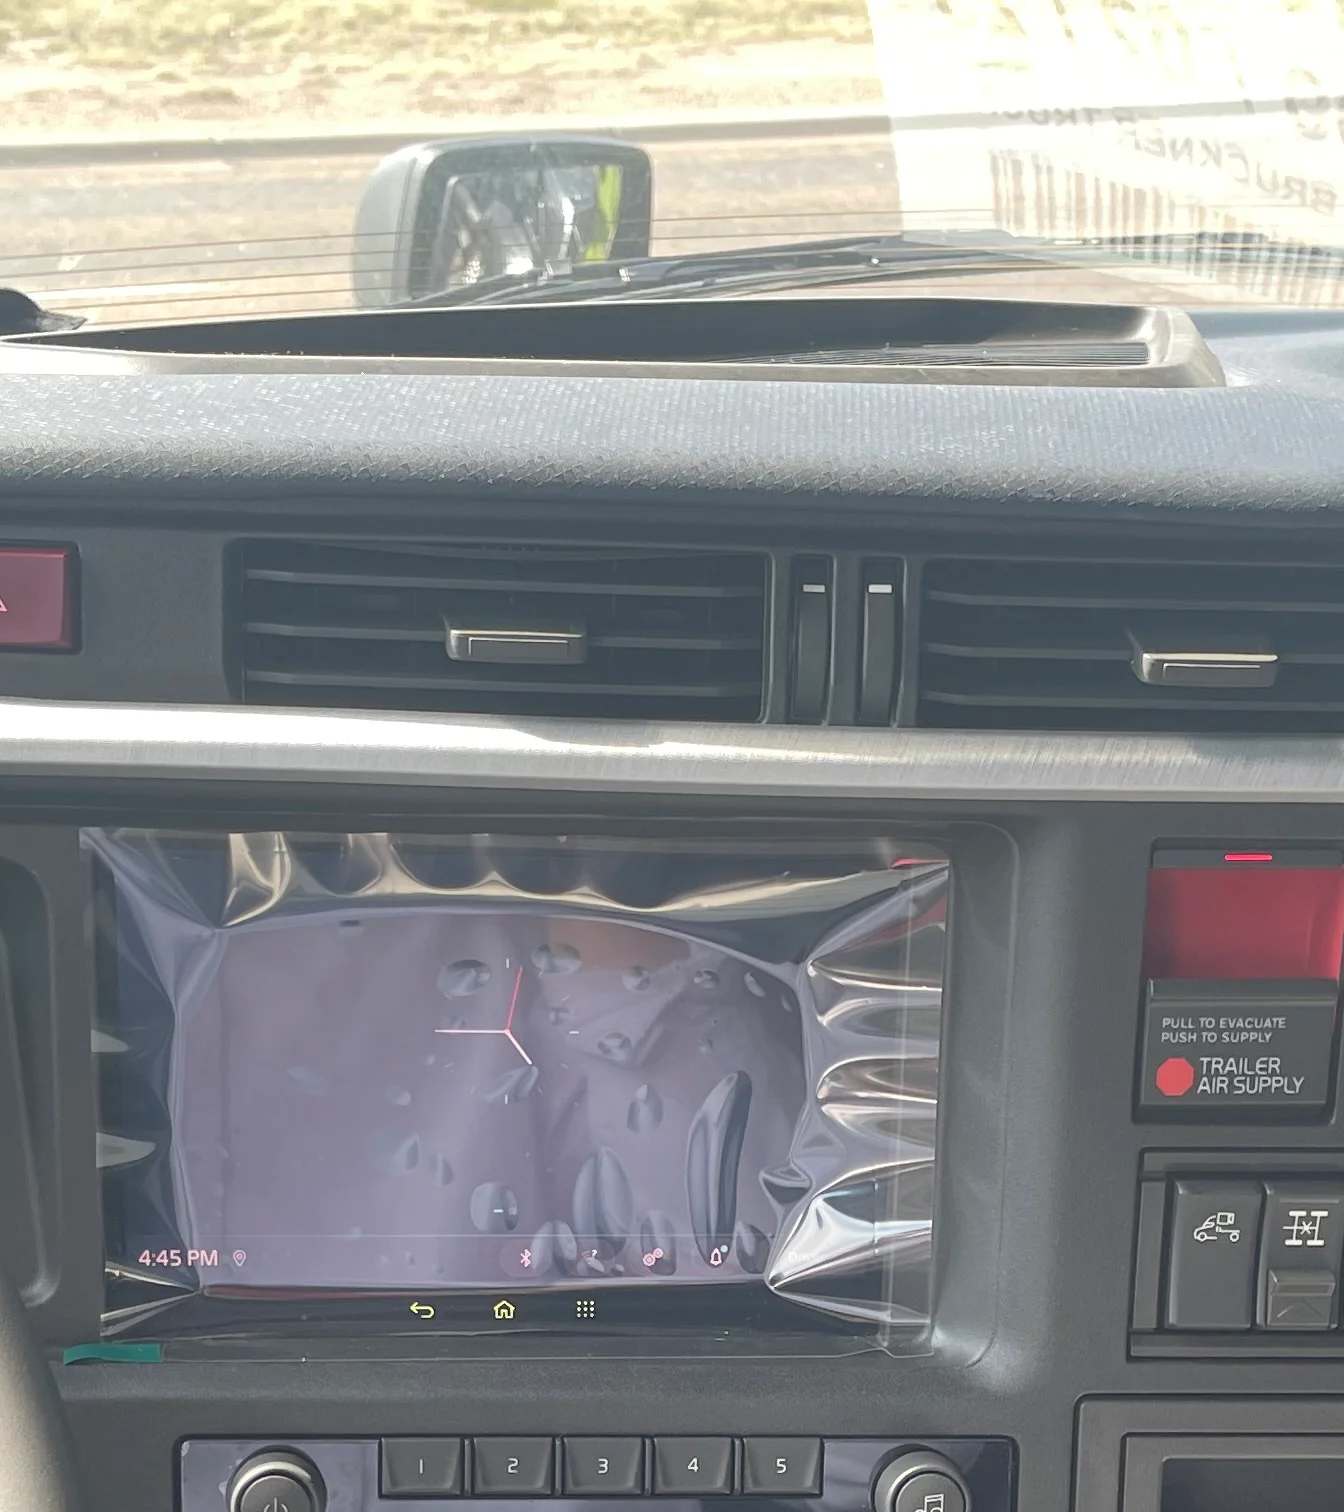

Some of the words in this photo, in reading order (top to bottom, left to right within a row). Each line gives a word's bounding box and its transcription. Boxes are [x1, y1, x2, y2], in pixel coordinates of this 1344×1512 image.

[1161, 1017, 1196, 1029] PULL
[1199, 1017, 1216, 1029] TO
[1219, 1017, 1287, 1029] EVACUATE
[1160, 1031, 1197, 1043] PUSH
[1201, 1031, 1218, 1043] TO
[1221, 1031, 1273, 1043] SUPPLY
[1199, 1057, 1281, 1075] TRAILER
[1197, 1076, 1228, 1095] AIR
[1233, 1076, 1305, 1095] SUPPLY
[138, 1249, 182, 1267] 4:45
[187, 1249, 219, 1267] PM
[418, 1458, 424, 1475] 1
[507, 1458, 519, 1475] 2
[597, 1458, 609, 1474] 3
[687, 1457, 699, 1474] 4
[775, 1458, 787, 1474] 5
